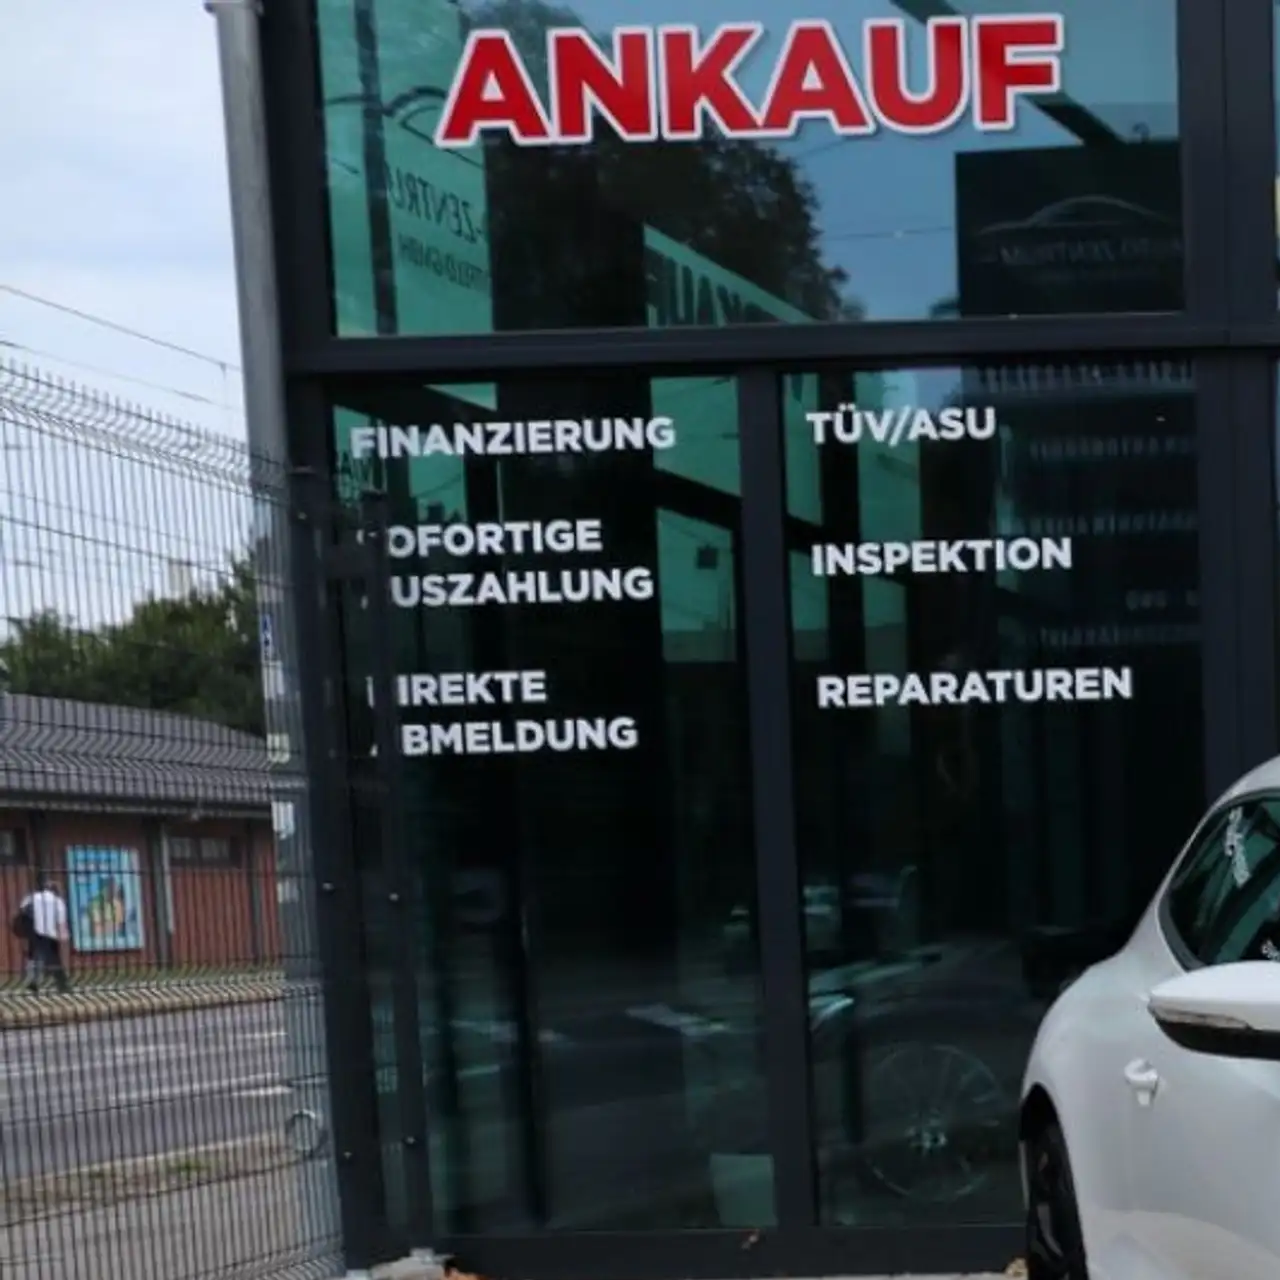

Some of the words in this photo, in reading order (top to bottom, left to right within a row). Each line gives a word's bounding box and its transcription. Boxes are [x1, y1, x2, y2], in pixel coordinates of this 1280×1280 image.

[435, 12, 1065, 148] ANKAUF
[350, 416, 676, 459] FINANZIERUNG
[806, 404, 997, 447] TÜV/ASU
[811, 537, 1073, 576] INSPEKTION
[361, 567, 655, 609] USZAHLUNG
[366, 670, 547, 708] IREKTE
[816, 667, 1134, 708] REPARATUREN
[370, 717, 639, 757] BMELDUNG
